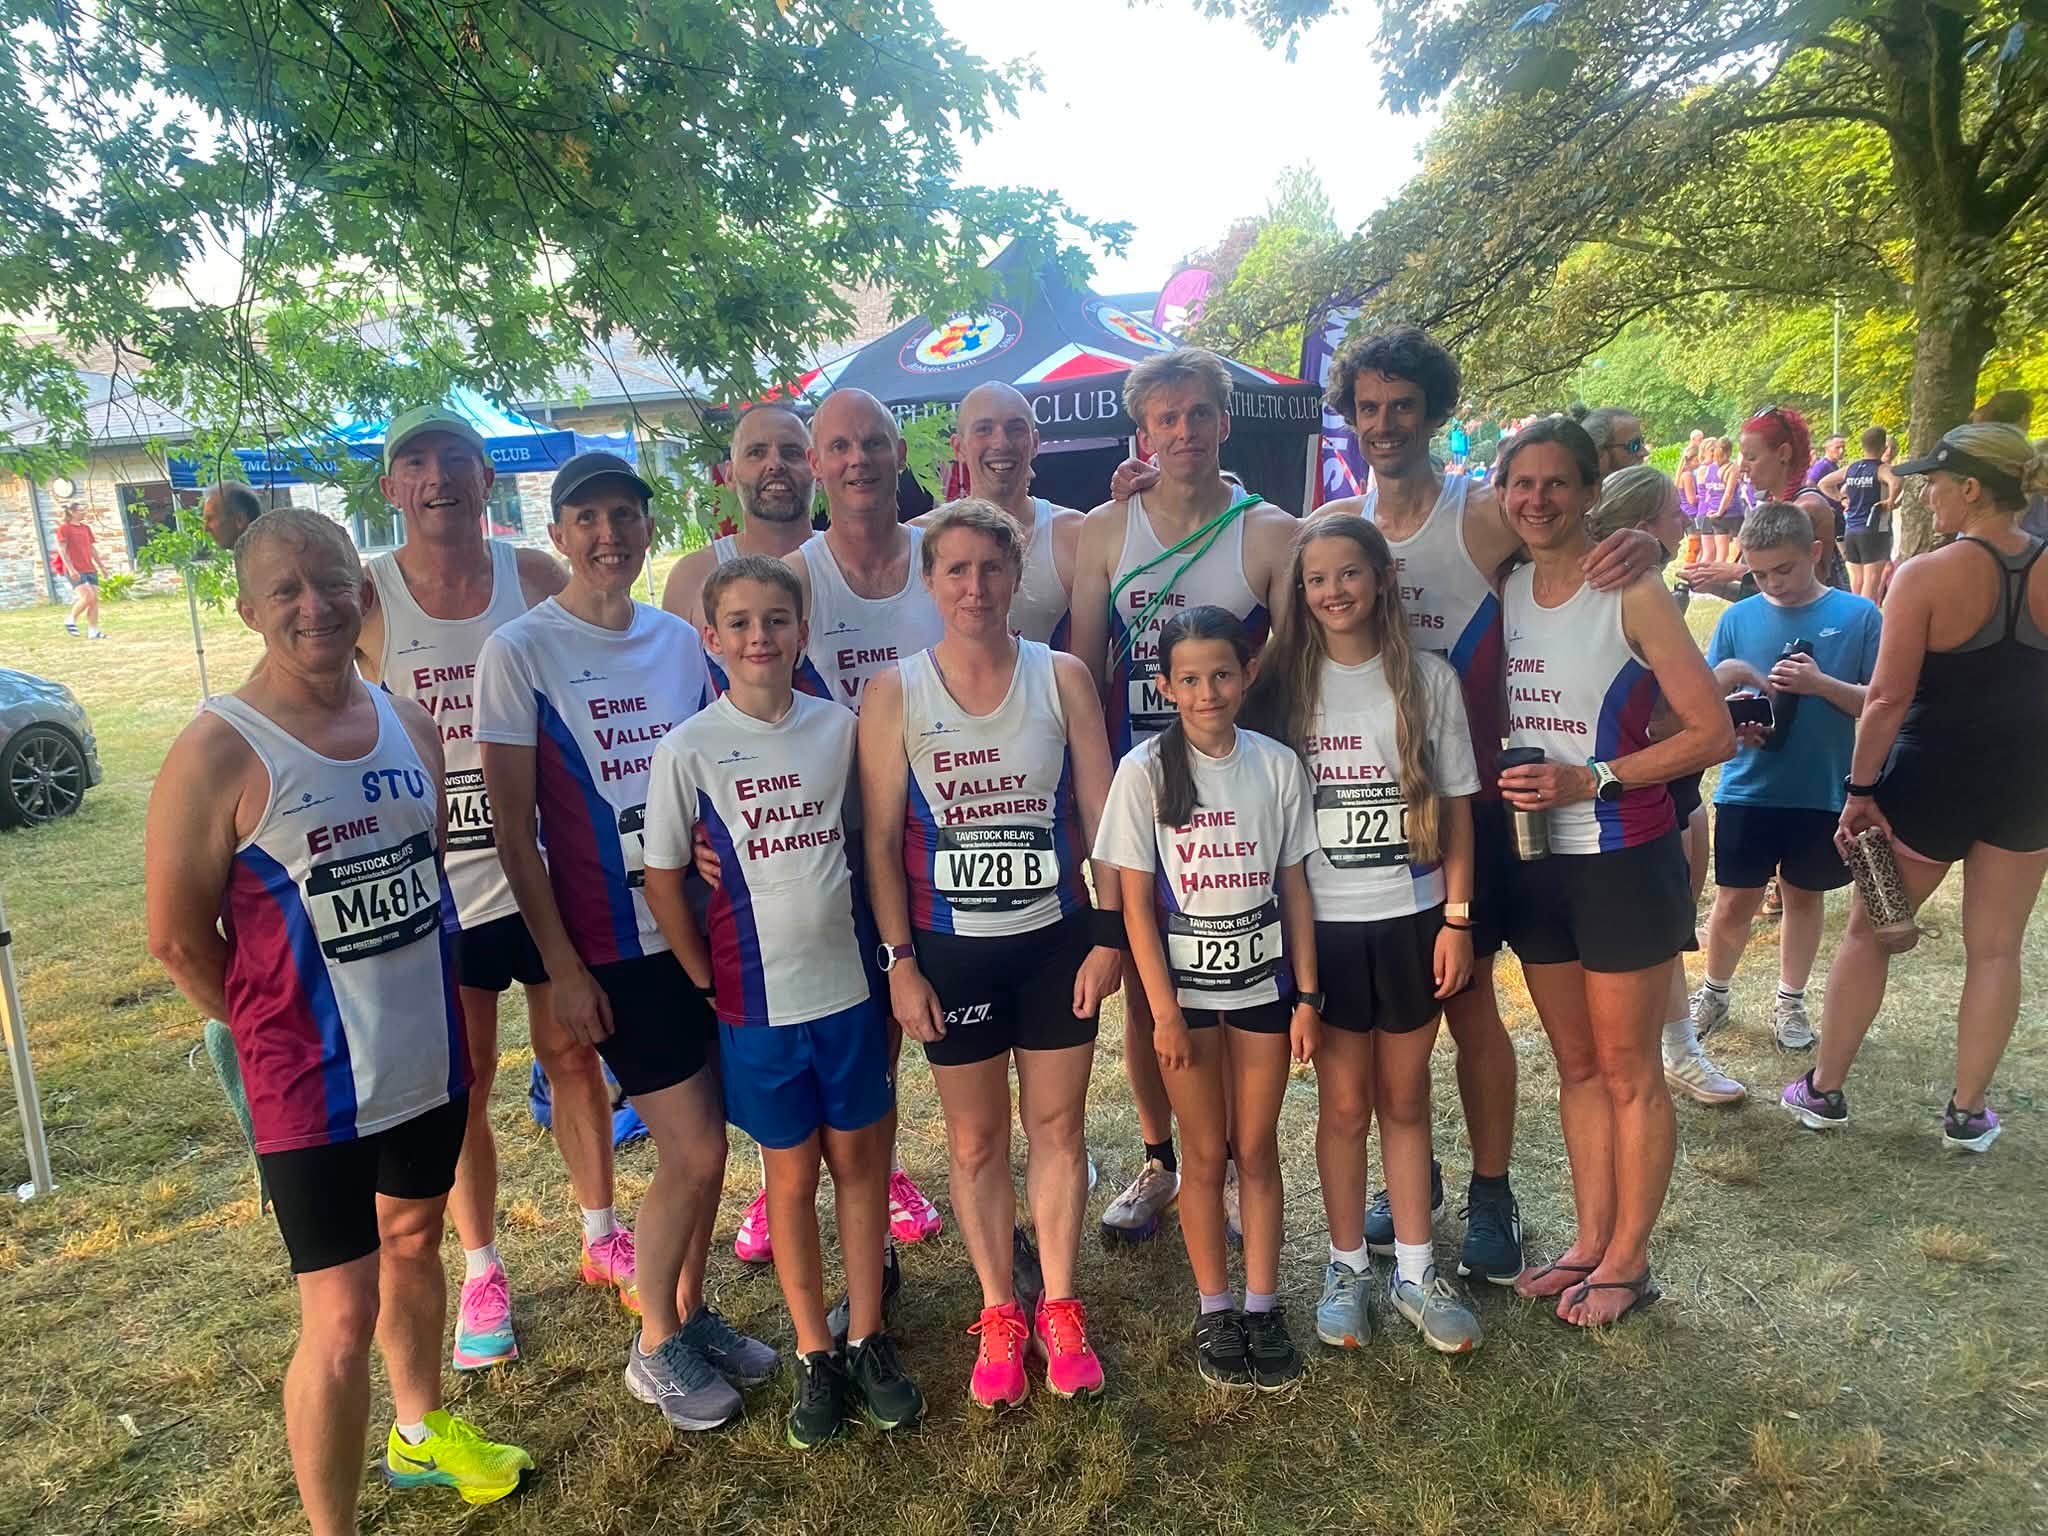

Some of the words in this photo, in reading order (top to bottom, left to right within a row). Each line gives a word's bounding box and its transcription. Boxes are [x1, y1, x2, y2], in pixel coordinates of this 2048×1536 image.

[1032, 389, 1118, 425] CLUB
[1289, 396, 1319, 420] CLUB
[490, 447, 531, 462] CLUB
[837, 646, 898, 670] ERME
[1507, 657, 1545, 676] ERME
[413, 664, 475, 690] ERME
[418, 693, 473, 716] VALL
[588, 697, 647, 720] ERME
[594, 722, 673, 750] VALLEY
[933, 748, 1000, 773] ERME
[362, 768, 425, 802] STU
[1310, 763, 1386, 784] VALLEY
[735, 773, 801, 800] ERME
[935, 774, 1027, 800] VALLEY
[1336, 787, 1383, 799] TAVISTOCK
[1385, 786, 1401, 796] REL
[741, 800, 824, 829] VALLEY
[944, 799, 1048, 826] HARRIERS
[306, 816, 380, 856] ERME
[955, 830, 1002, 841] TAVISTOCK
[1004, 830, 1035, 841] RELAYS
[1339, 809, 1389, 844] J22
[747, 827, 841, 860] HARRIERS
[1176, 841, 1258, 864] VALLEY
[329, 855, 390, 879] TAVISTOCK
[949, 853, 1013, 888] W28
[1024, 852, 1042, 886] B
[1180, 871, 1271, 894] HARRIER
[331, 868, 430, 934] M48A
[1188, 917, 1235, 930] TAVISTOCK
[1189, 940, 1240, 971] J23
[1249, 932, 1263, 963] C
